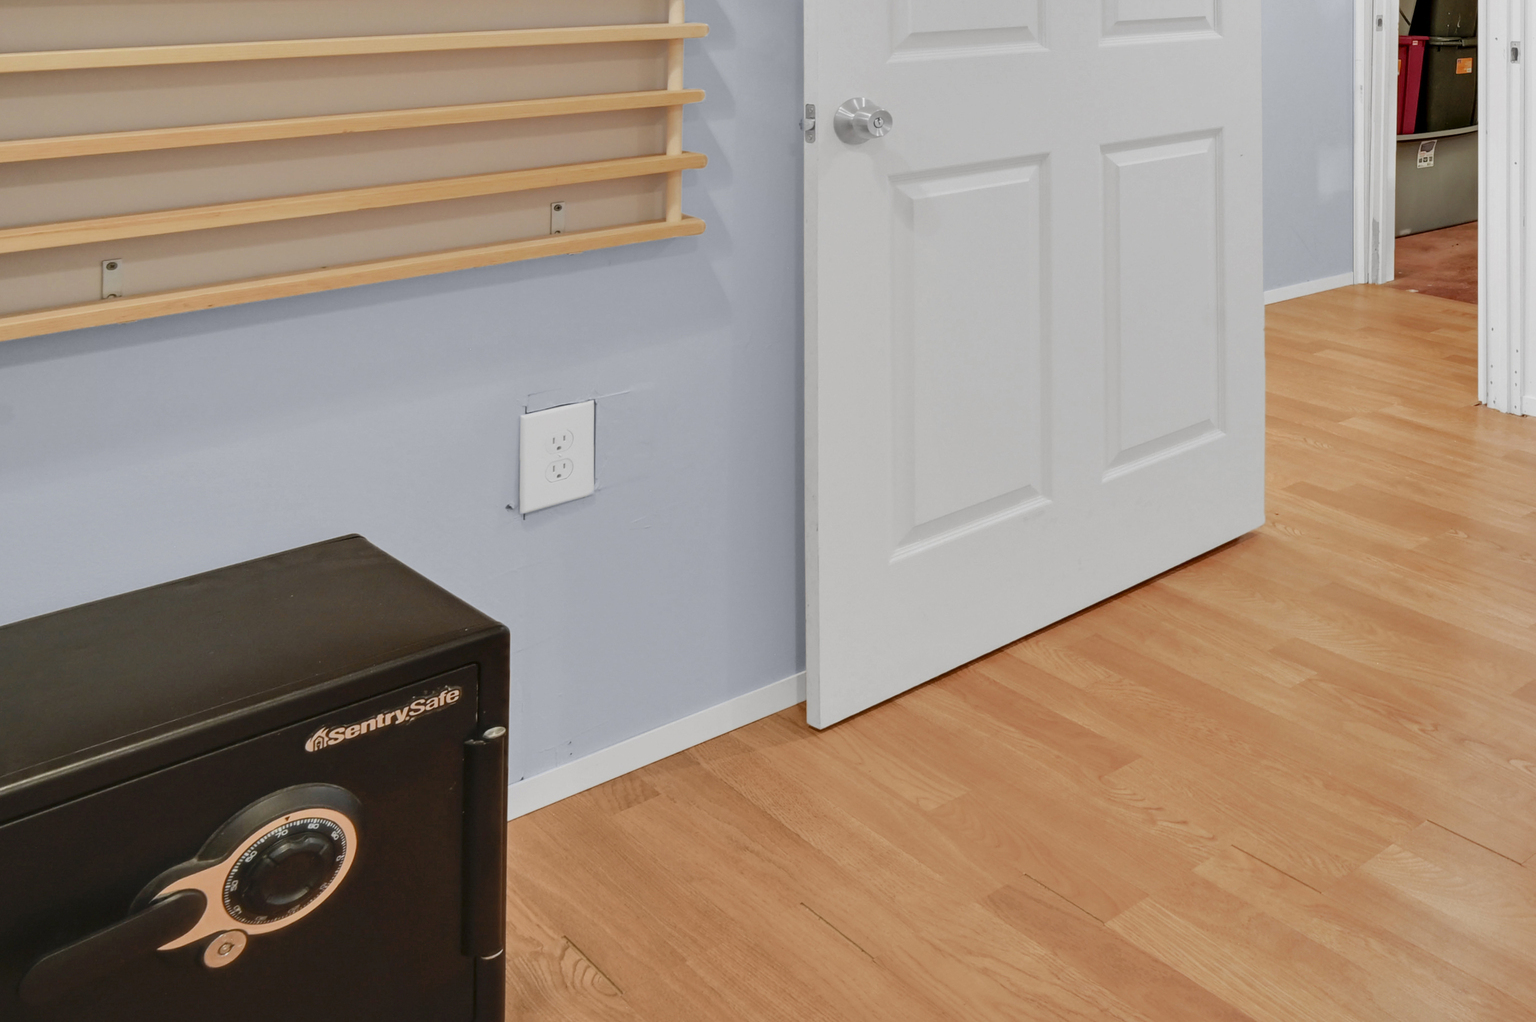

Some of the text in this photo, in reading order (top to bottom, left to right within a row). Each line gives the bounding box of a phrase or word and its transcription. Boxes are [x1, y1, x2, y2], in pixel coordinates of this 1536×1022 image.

[328, 689, 460, 745] SentrySafe
[275, 829, 289, 839] 70
[245, 850, 258, 863] 60
